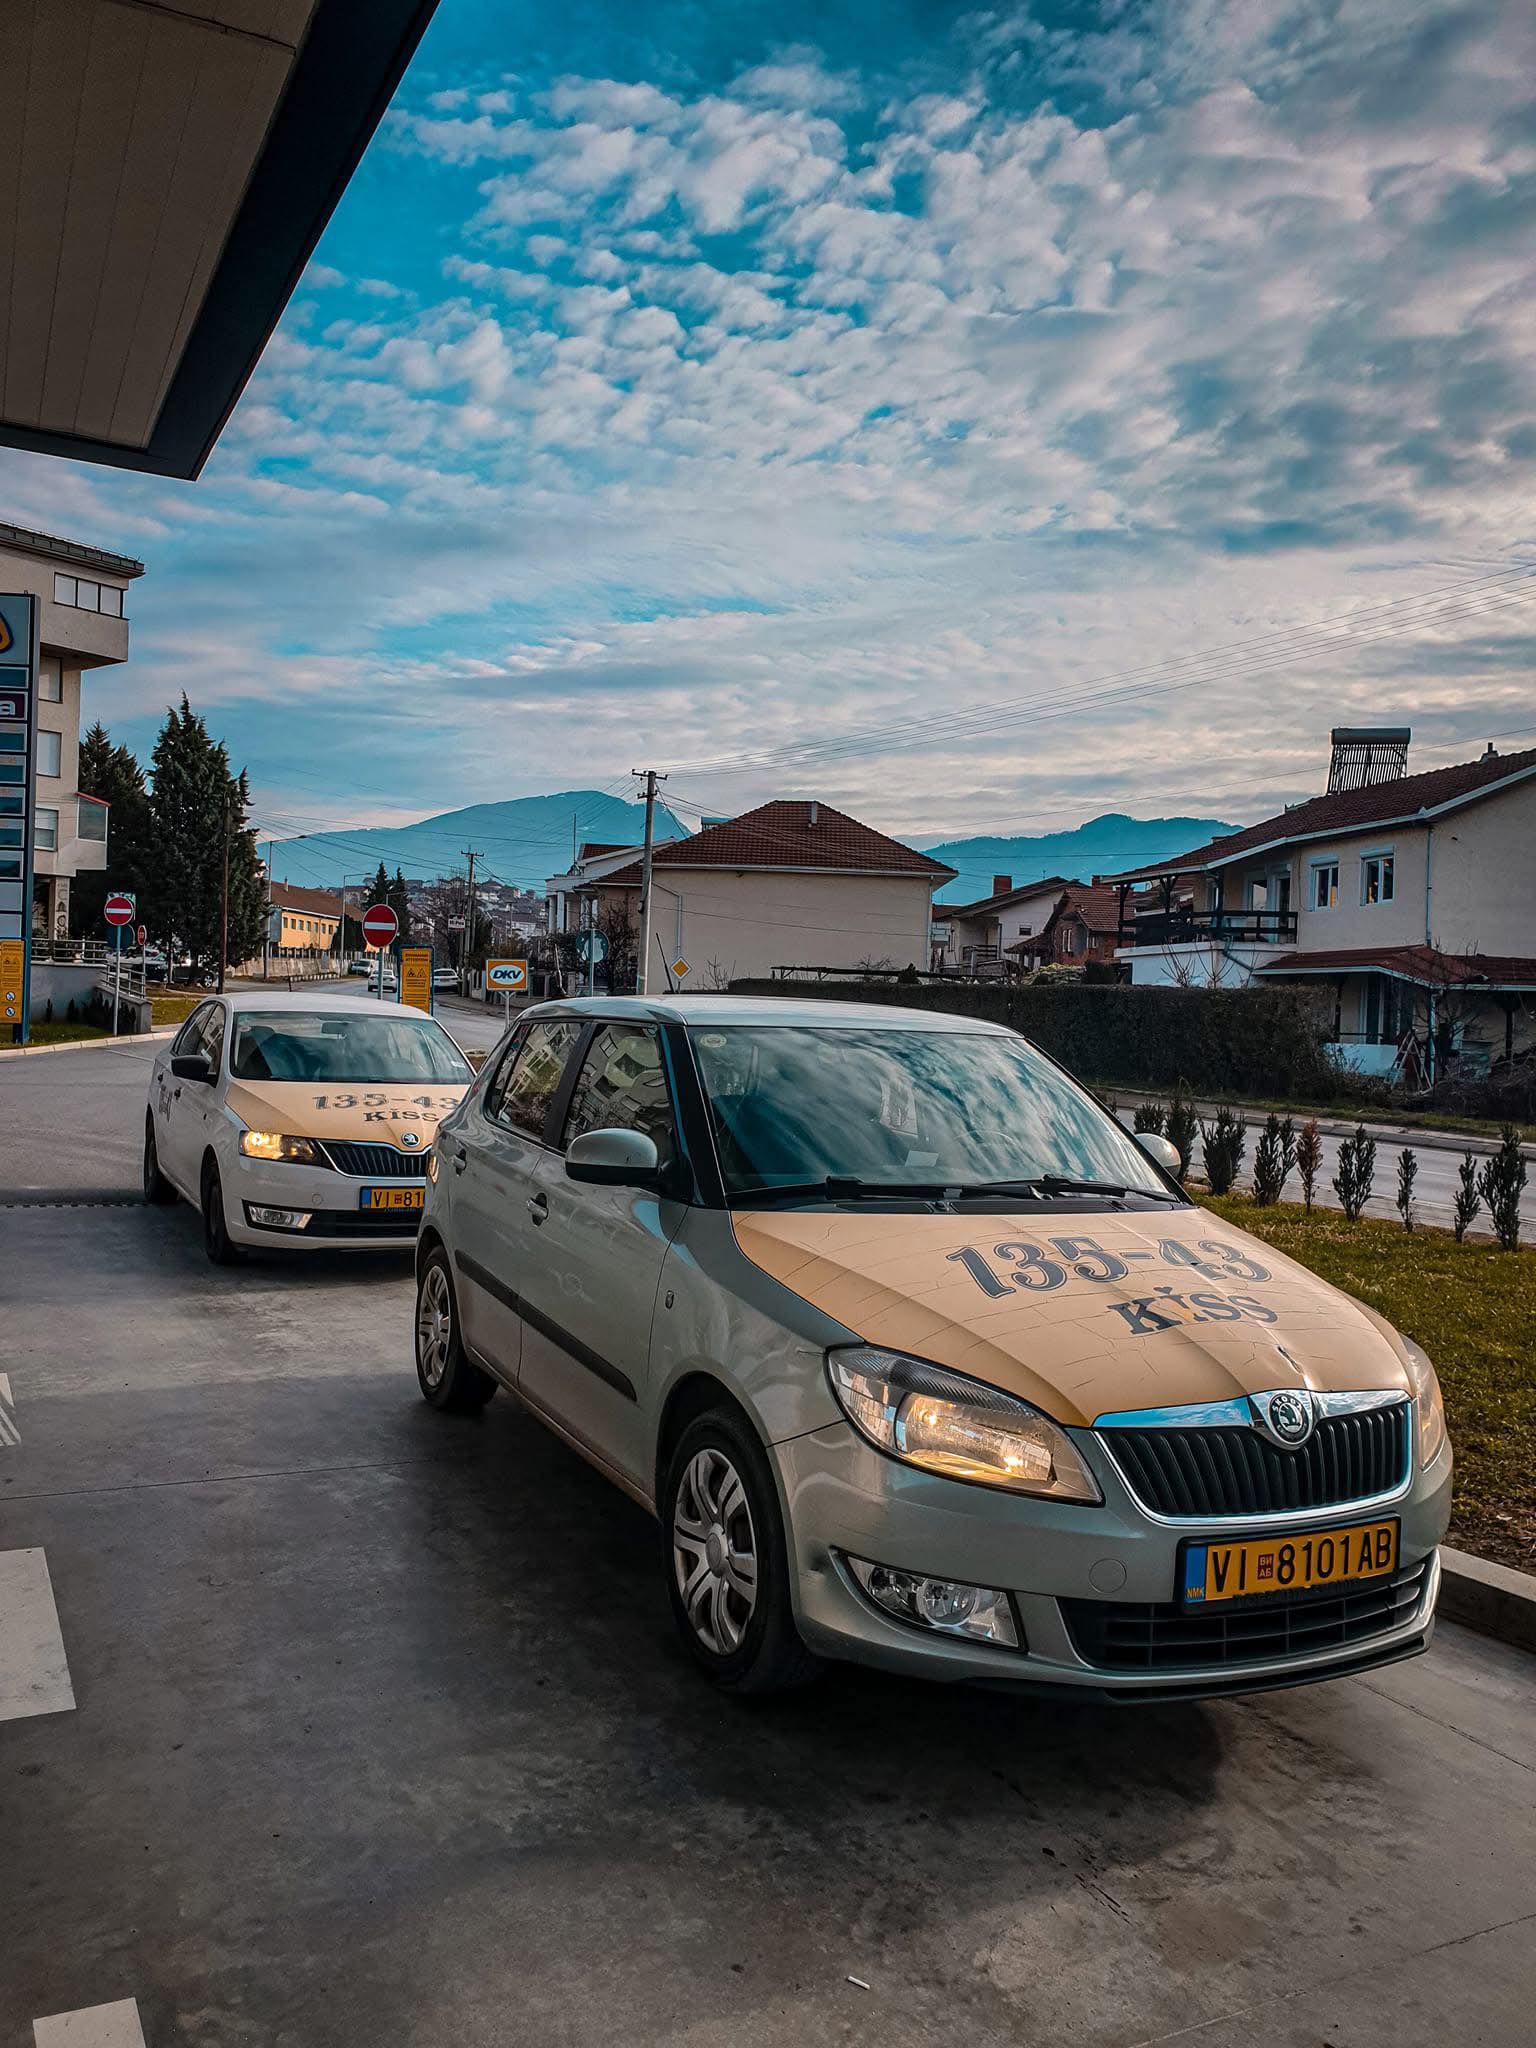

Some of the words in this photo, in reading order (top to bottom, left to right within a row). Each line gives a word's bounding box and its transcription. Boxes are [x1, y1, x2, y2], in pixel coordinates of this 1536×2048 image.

[493, 970, 521, 979] DKV
[312, 1093, 459, 1110] 135-43
[374, 1191, 389, 1207] VI
[404, 1191, 425, 1207] 81
[946, 1236, 1272, 1299] 135-43
[1212, 1549, 1247, 1593] VI
[1277, 1528, 1392, 1585] 8101AB
